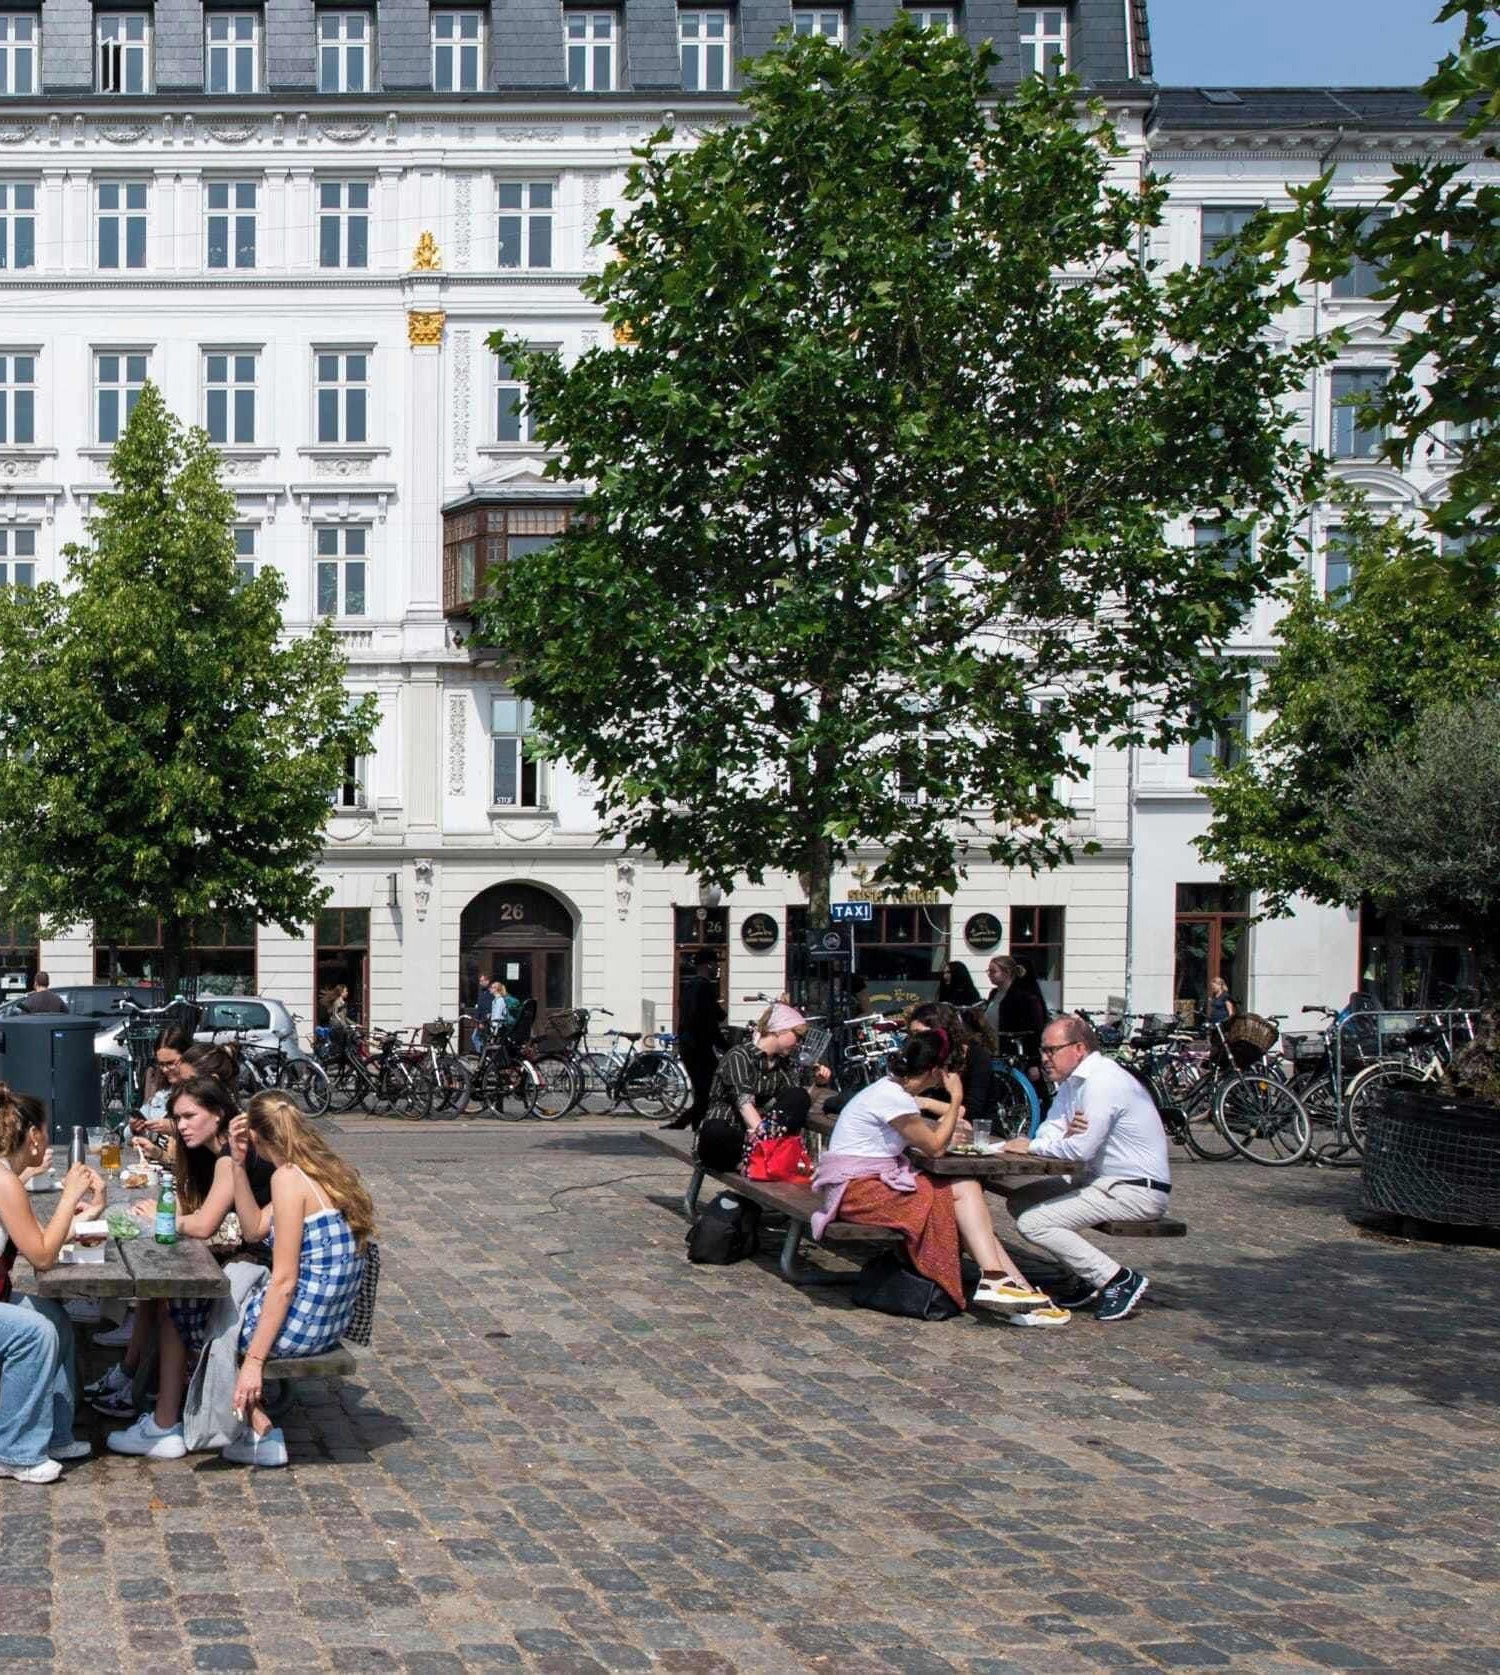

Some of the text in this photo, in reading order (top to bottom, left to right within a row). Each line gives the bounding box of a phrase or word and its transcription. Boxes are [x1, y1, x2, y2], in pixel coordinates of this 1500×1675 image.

[500, 903, 524, 921] 26
[834, 905, 869, 918] TAXI
[707, 920, 723, 933] 26
